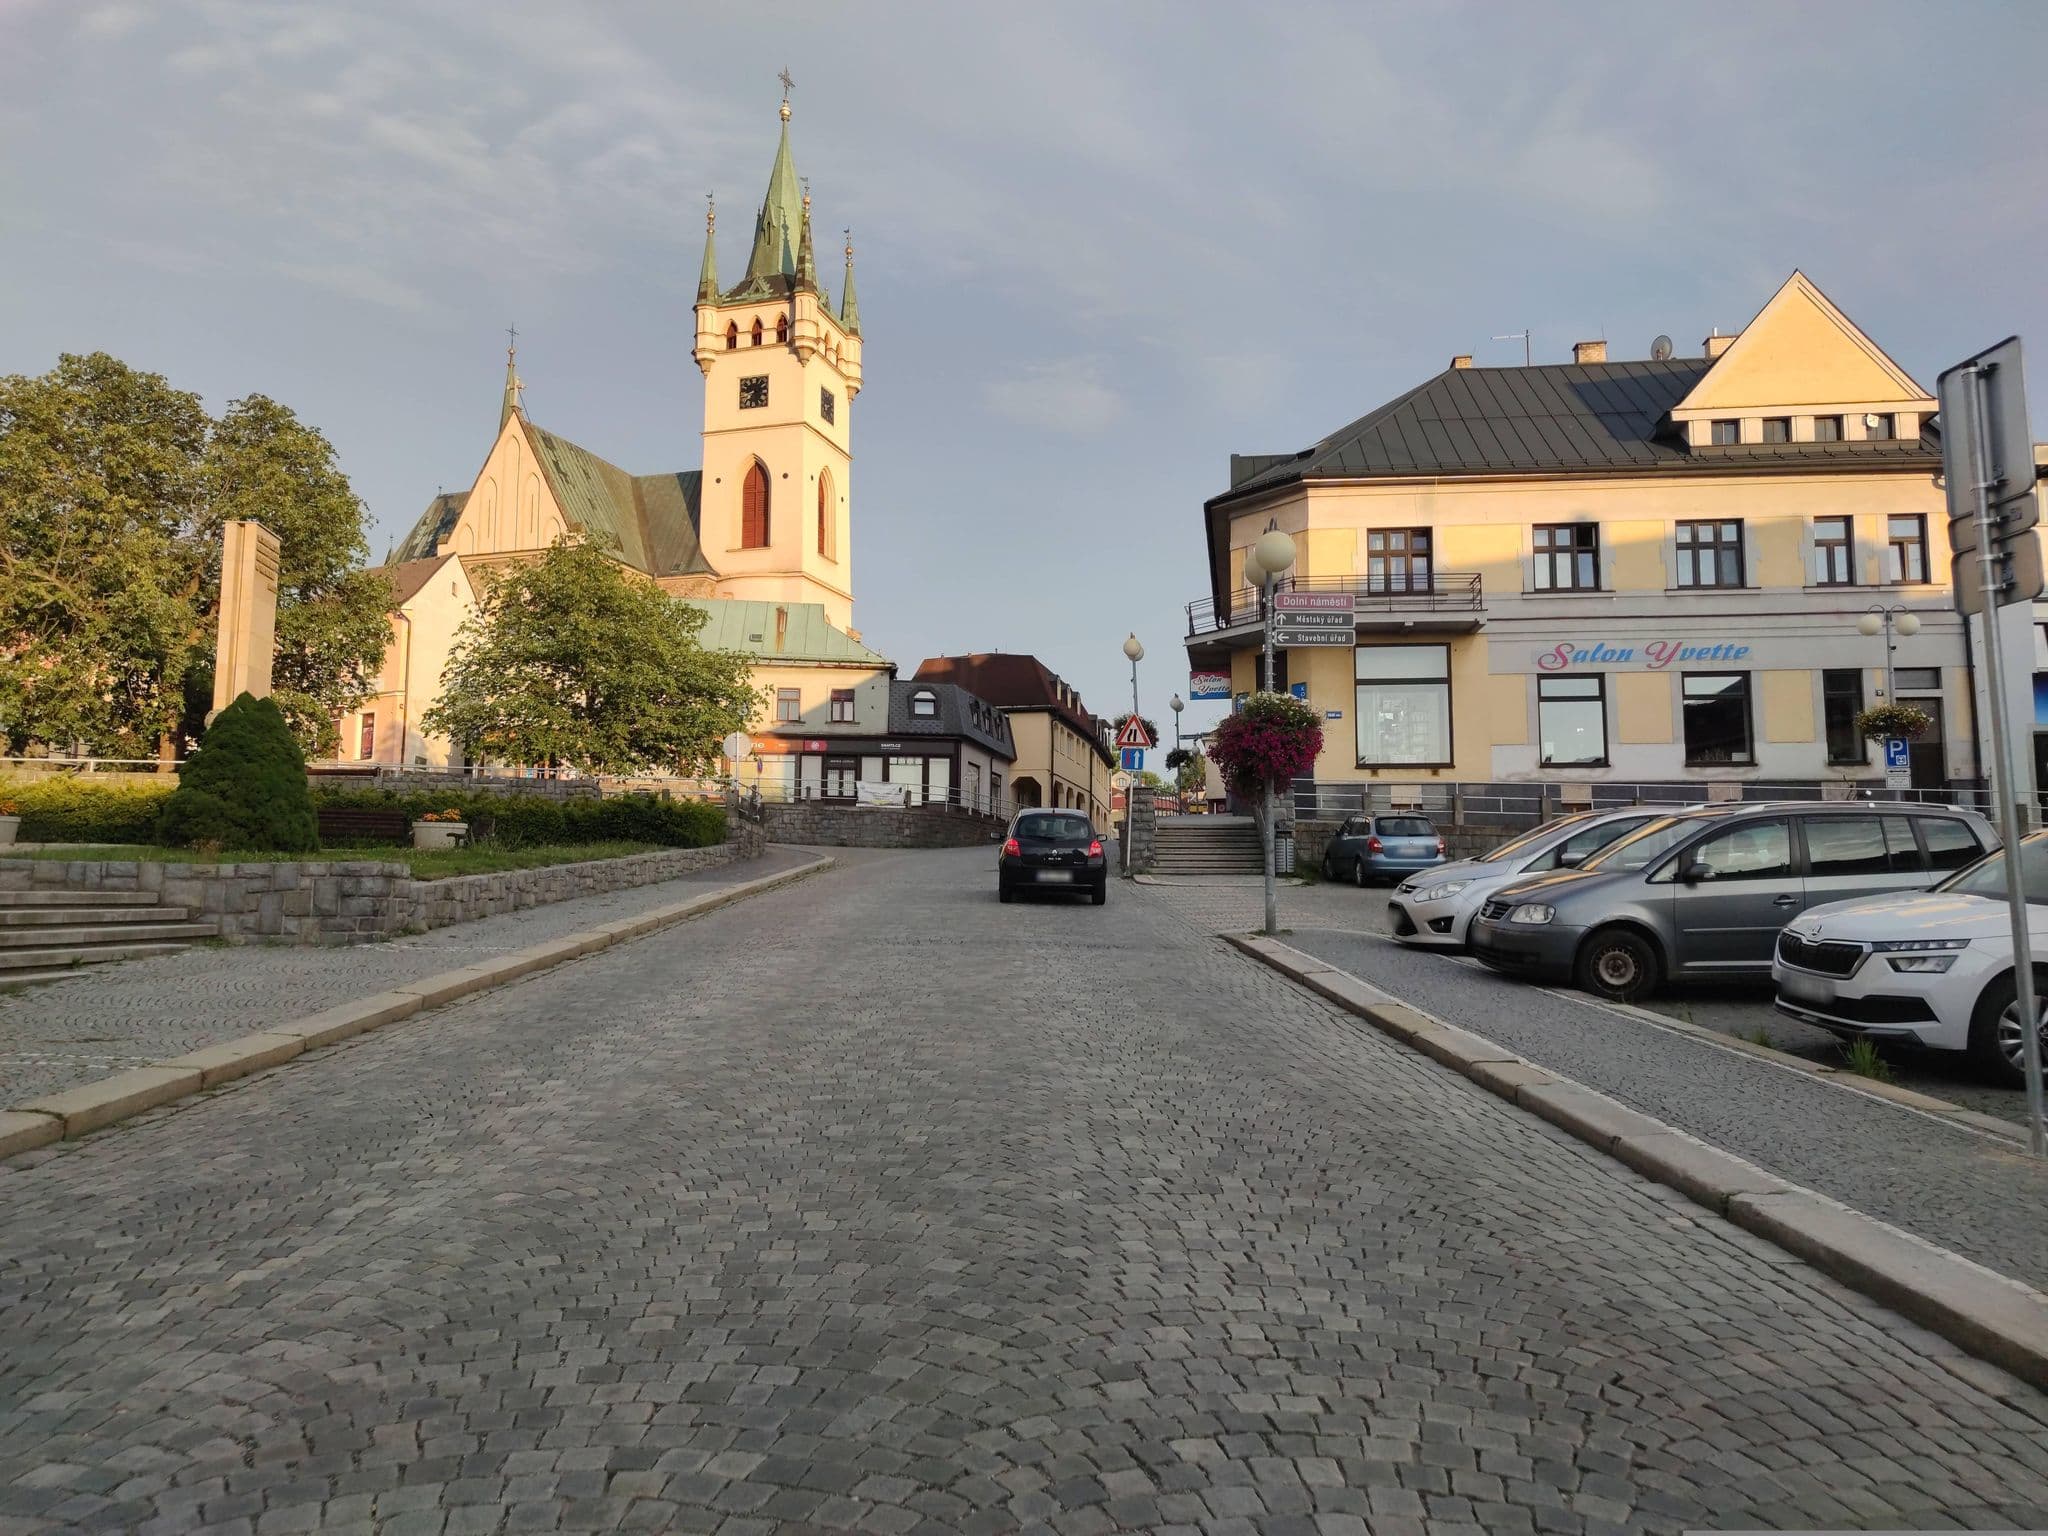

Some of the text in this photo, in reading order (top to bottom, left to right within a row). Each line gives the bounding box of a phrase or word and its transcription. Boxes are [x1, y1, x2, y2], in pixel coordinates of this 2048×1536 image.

[1283, 596, 1347, 607] Dolní náměstí
[1296, 615, 1343, 625] Městský úřad
[1297, 633, 1346, 642] Stavební úřad
[1537, 640, 1750, 671] Salon Yvette
[1193, 674, 1223, 685] Salon
[1198, 685, 1230, 695] Yvette
[1889, 740, 1903, 758] P
